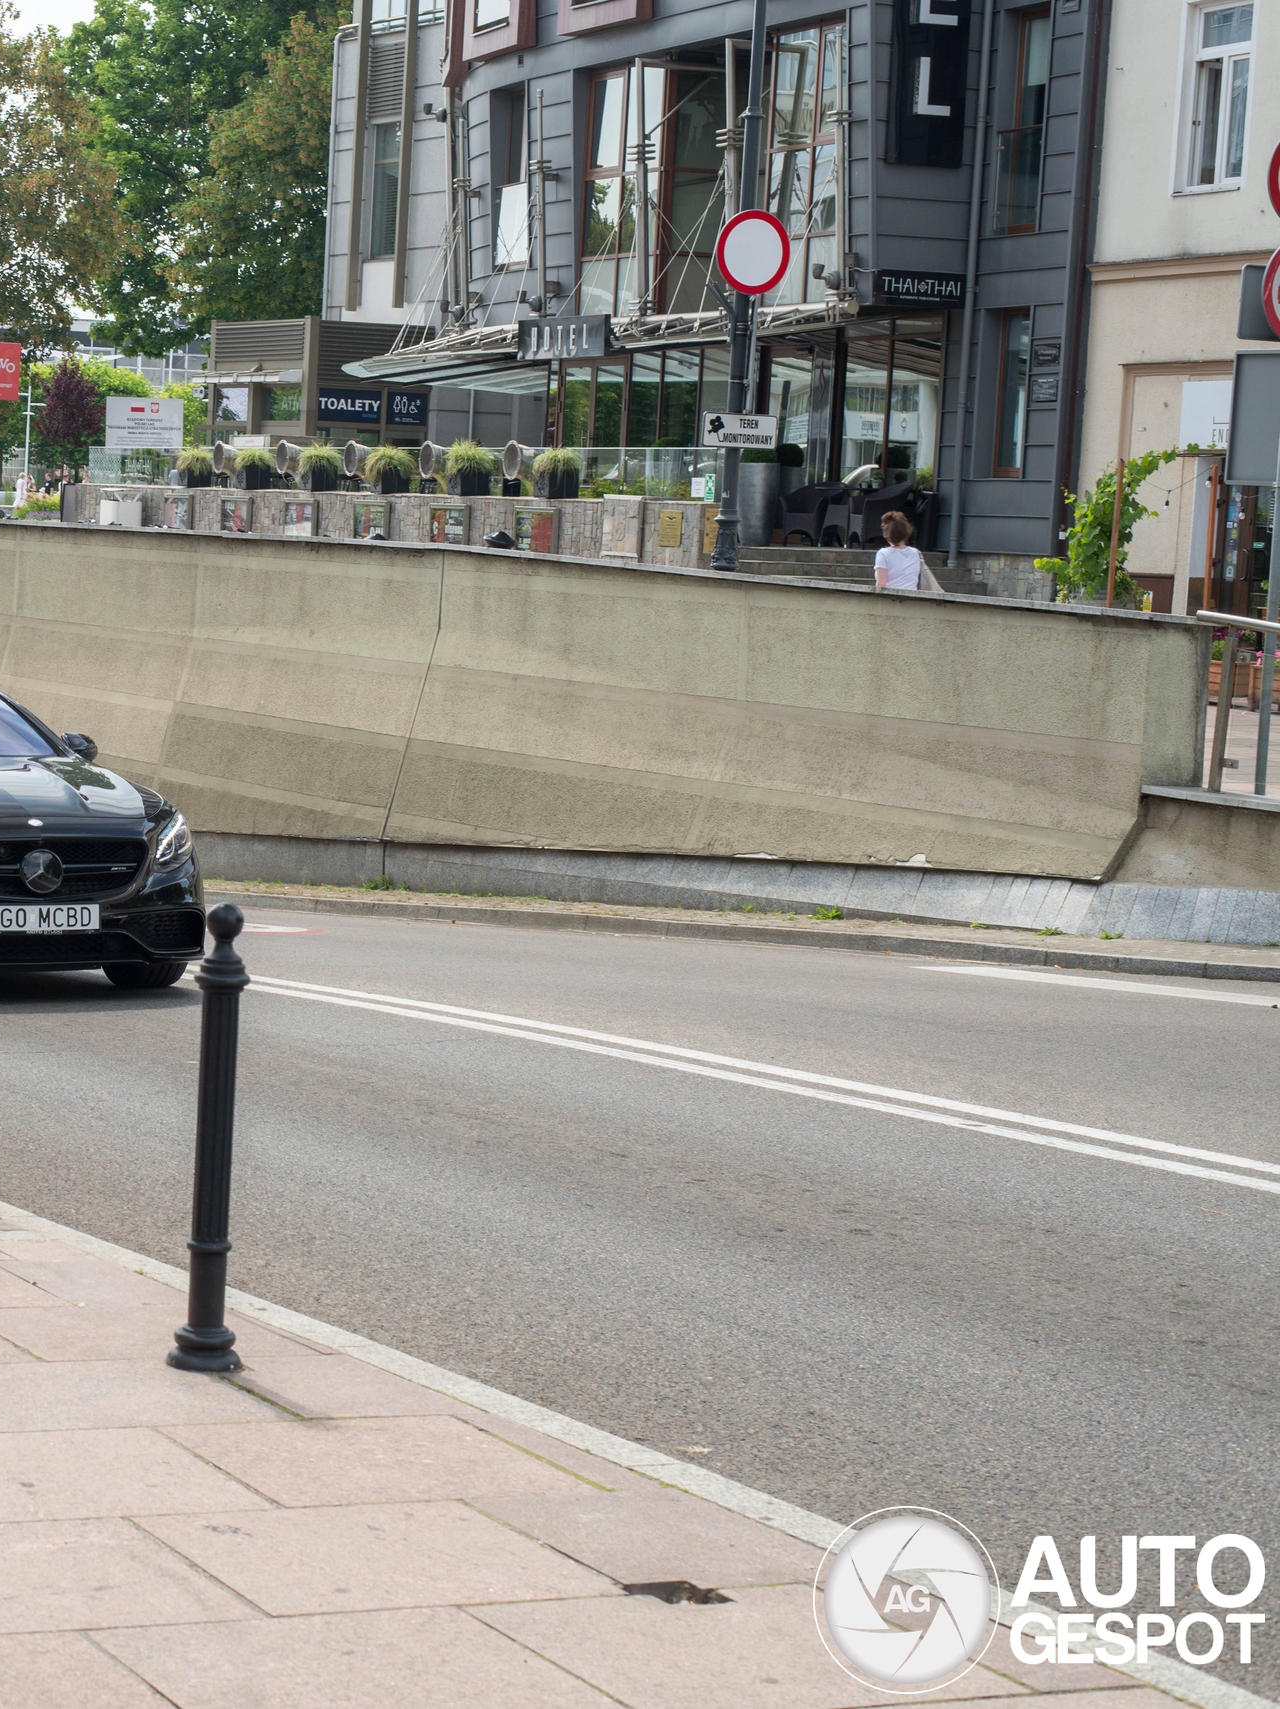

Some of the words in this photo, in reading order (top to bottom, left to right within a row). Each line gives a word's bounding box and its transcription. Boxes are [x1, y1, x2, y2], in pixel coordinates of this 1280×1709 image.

[882, 276, 918, 293] THAI
[925, 280, 960, 296] THAI
[530, 323, 589, 352] HOTEL
[318, 397, 381, 412] TOALETY
[739, 418, 760, 429] TEREN
[723, 433, 774, 445] MONITOROWANY
[38, 906, 92, 928] MCBD
